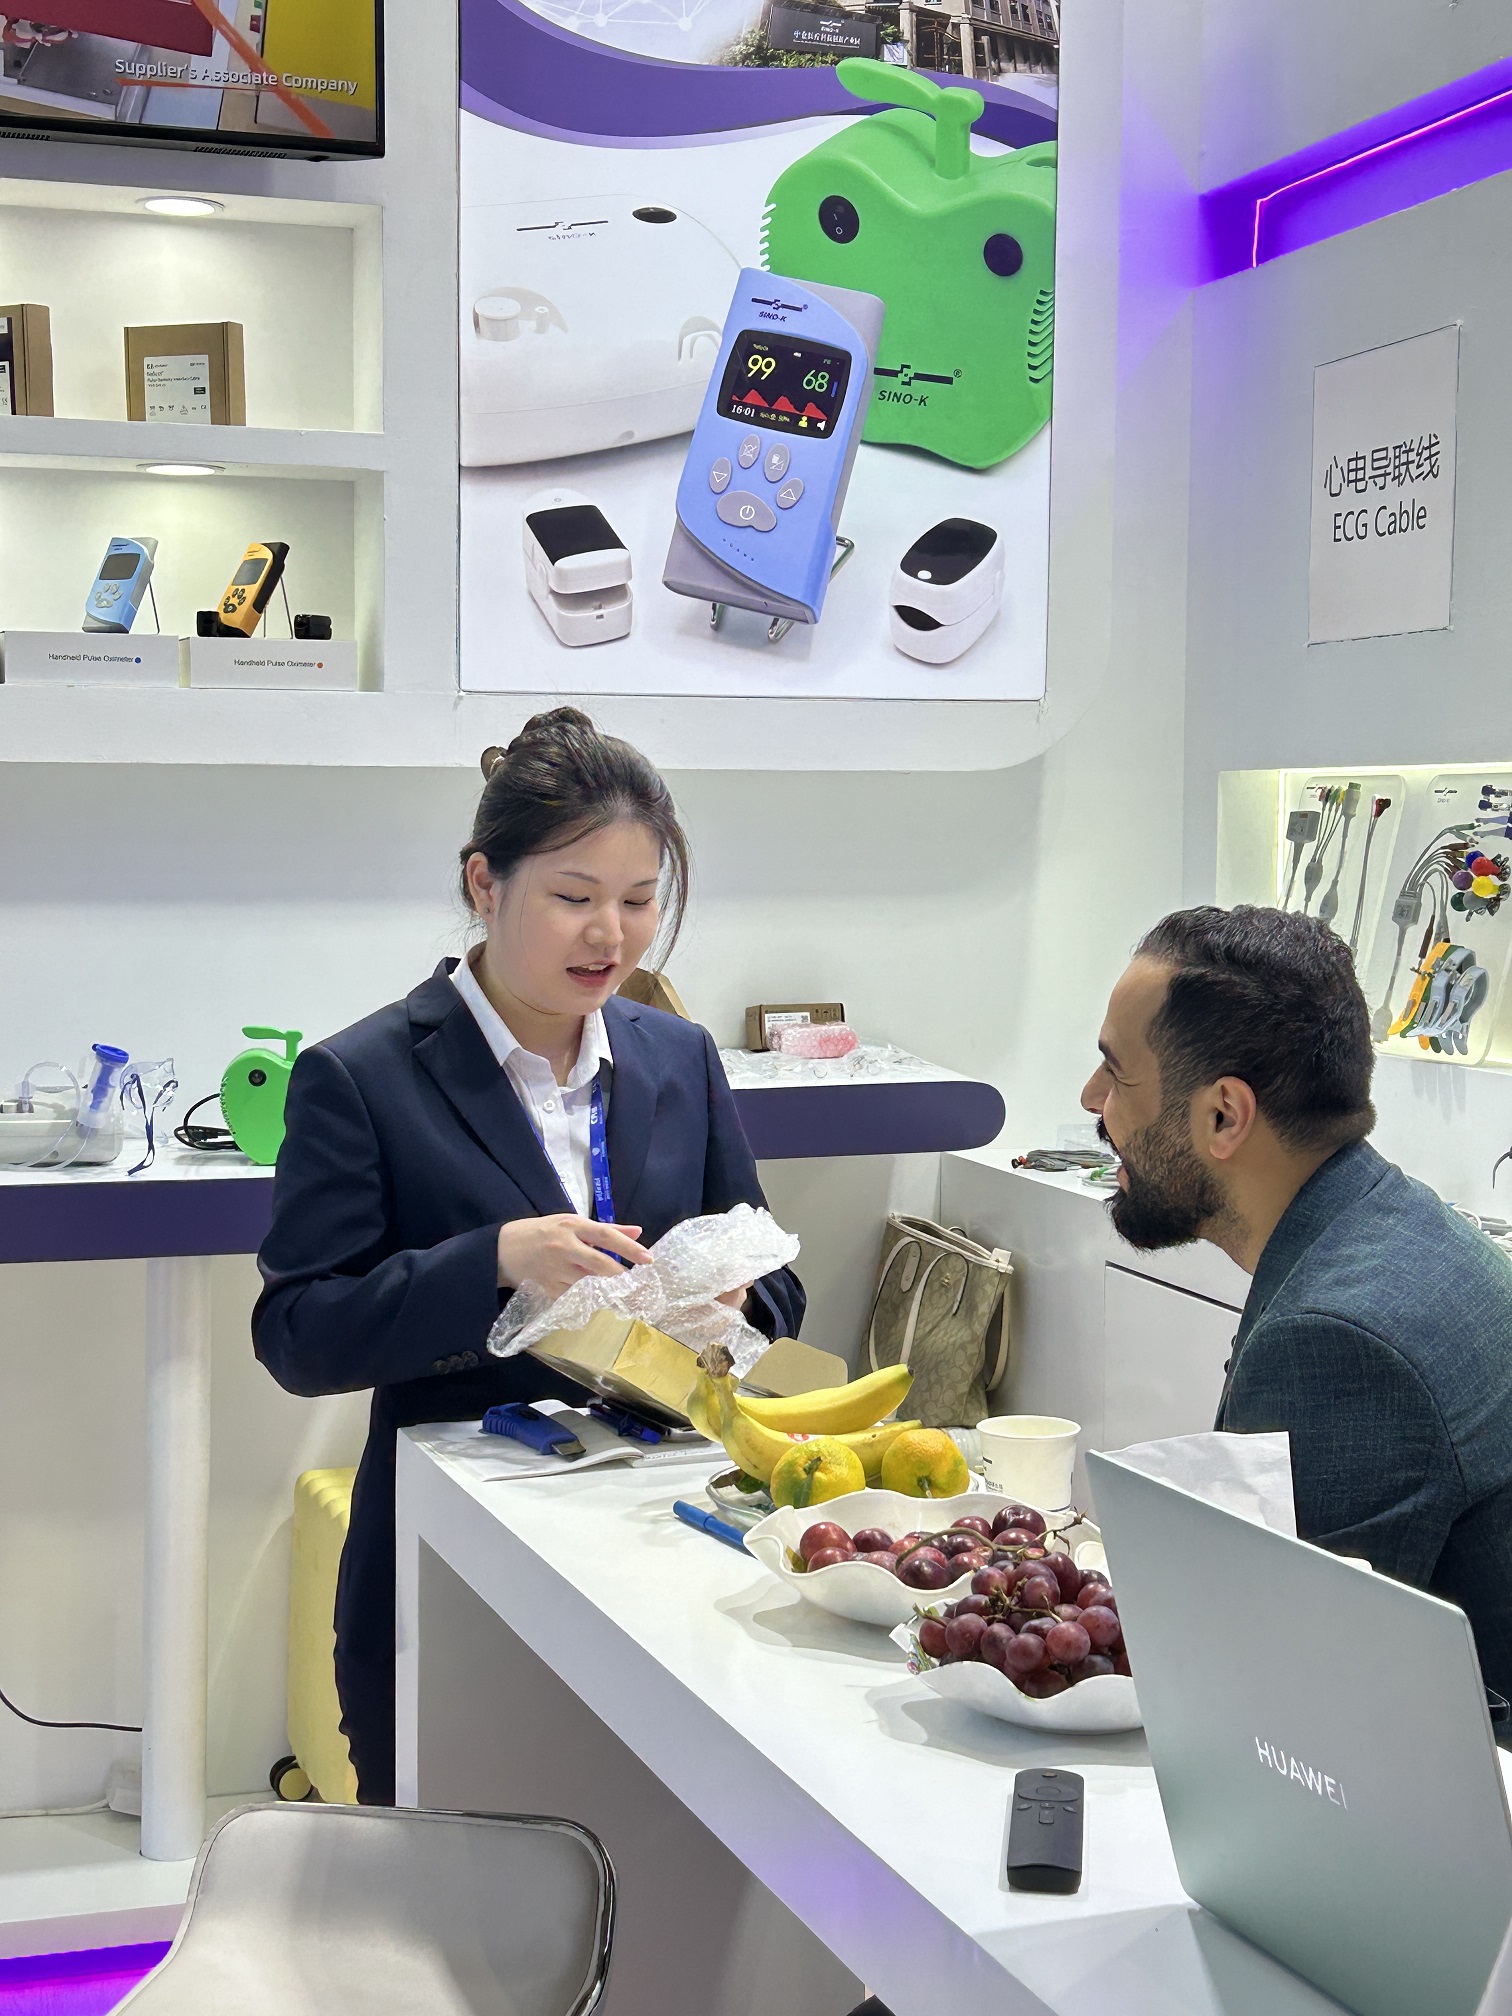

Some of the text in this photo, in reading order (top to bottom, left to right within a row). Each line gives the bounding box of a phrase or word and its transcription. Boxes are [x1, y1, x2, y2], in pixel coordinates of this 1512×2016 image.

[115, 59, 358, 95] Supplier's Associate Company
[758, 311, 788, 323] SINO-K
[747, 354, 776, 381] 99
[802, 369, 830, 393] 68
[878, 390, 929, 407] SINO-K
[1323, 433, 1441, 498] 心电导联线
[1333, 498, 1427, 543] ECG Cable
[234, 659, 266, 667] Handheld
[1255, 1736, 1348, 1811] HUAWEI
